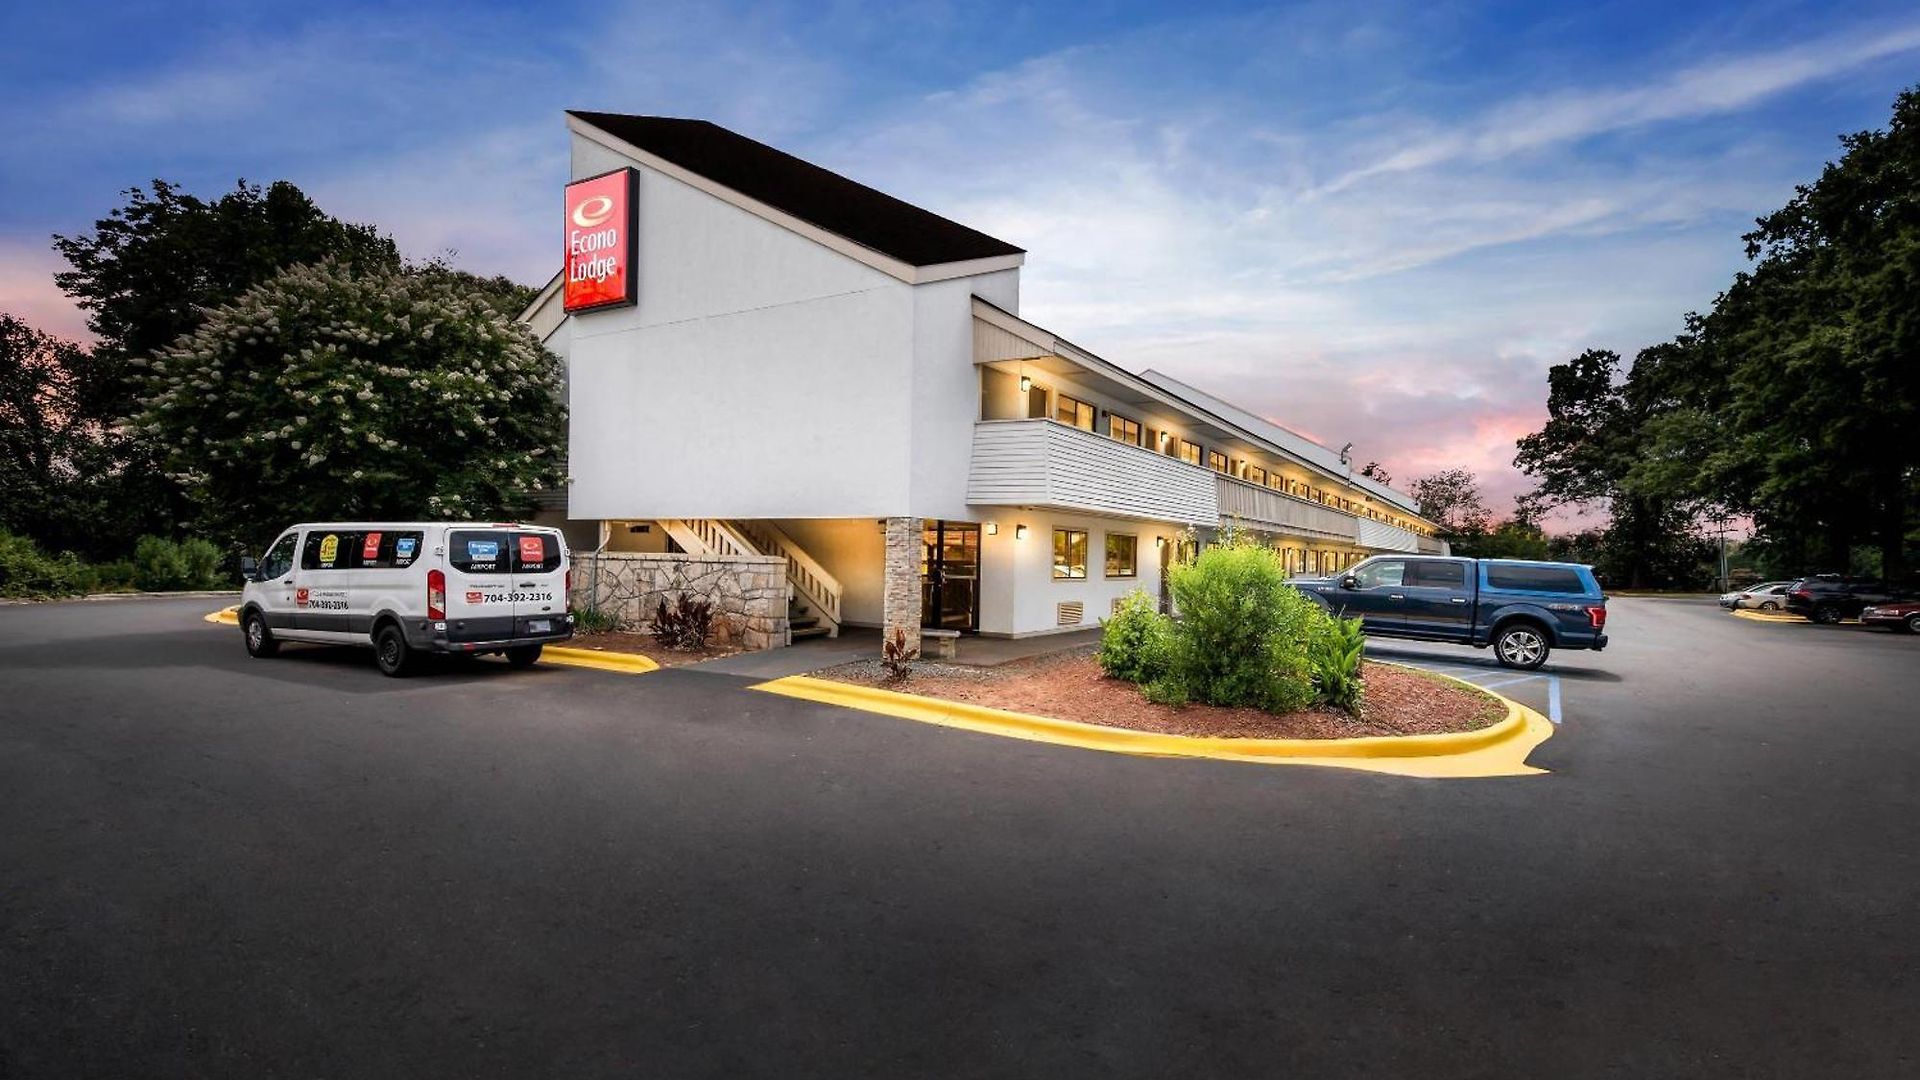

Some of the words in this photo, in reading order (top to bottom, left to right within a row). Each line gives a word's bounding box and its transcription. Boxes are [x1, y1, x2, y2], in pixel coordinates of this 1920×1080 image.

[571, 229, 617, 255] Econo
[571, 254, 616, 283] Lodge
[484, 592, 553, 603] 704-392-2316
